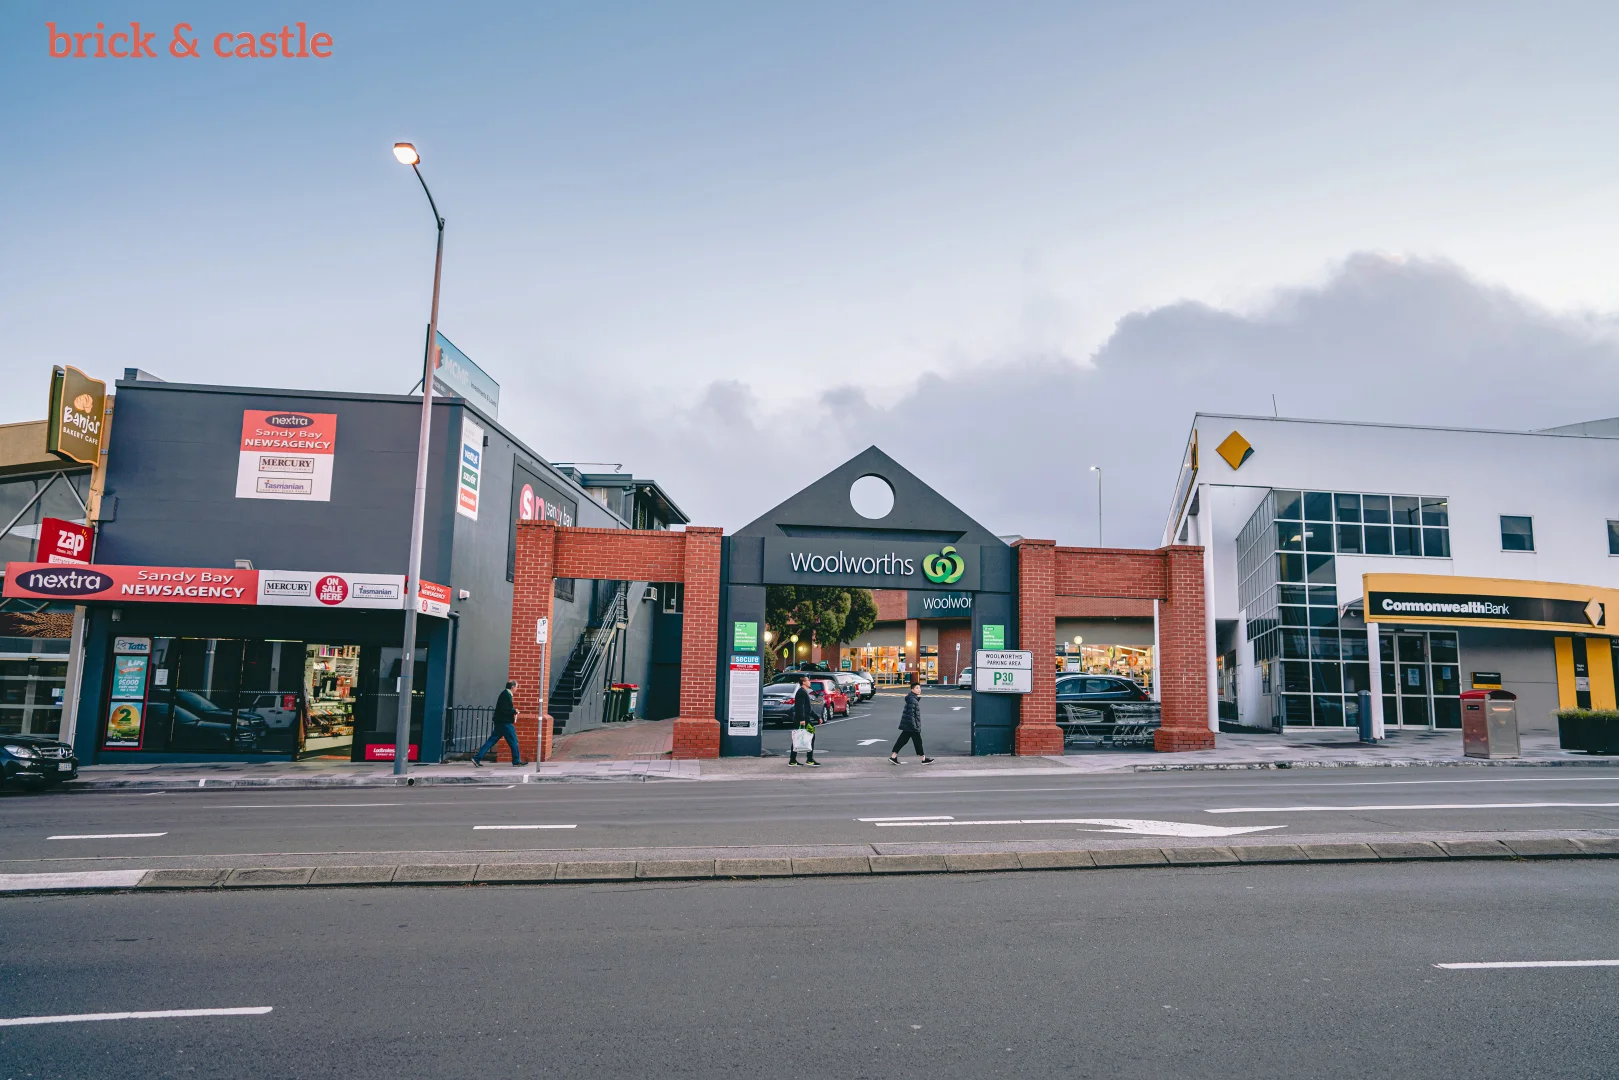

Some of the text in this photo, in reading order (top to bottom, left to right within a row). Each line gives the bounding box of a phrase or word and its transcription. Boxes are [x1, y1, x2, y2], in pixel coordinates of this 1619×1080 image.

[63, 405, 100, 434] Banjo's
[271, 415, 308, 426] nextra
[63, 426, 83, 439] BAKERY
[255, 428, 323, 440] Sandy Bay
[244, 438, 331, 450] NEWSAGENCY
[261, 458, 312, 468] MERCURY
[264, 481, 304, 490] Tasmanian
[57, 529, 85, 556] zap
[790, 550, 914, 576] Woolworths
[29, 571, 101, 590] nextra
[138, 570, 234, 585] Sandy Bay
[326, 577, 339, 585] ON
[121, 584, 245, 598] NEWSAGENCY
[266, 582, 310, 591] MERCURY
[321, 585, 343, 593] SALE
[359, 587, 392, 595] Tasmanian
[320, 593, 343, 601] HERE
[127, 642, 148, 650] Tatts
